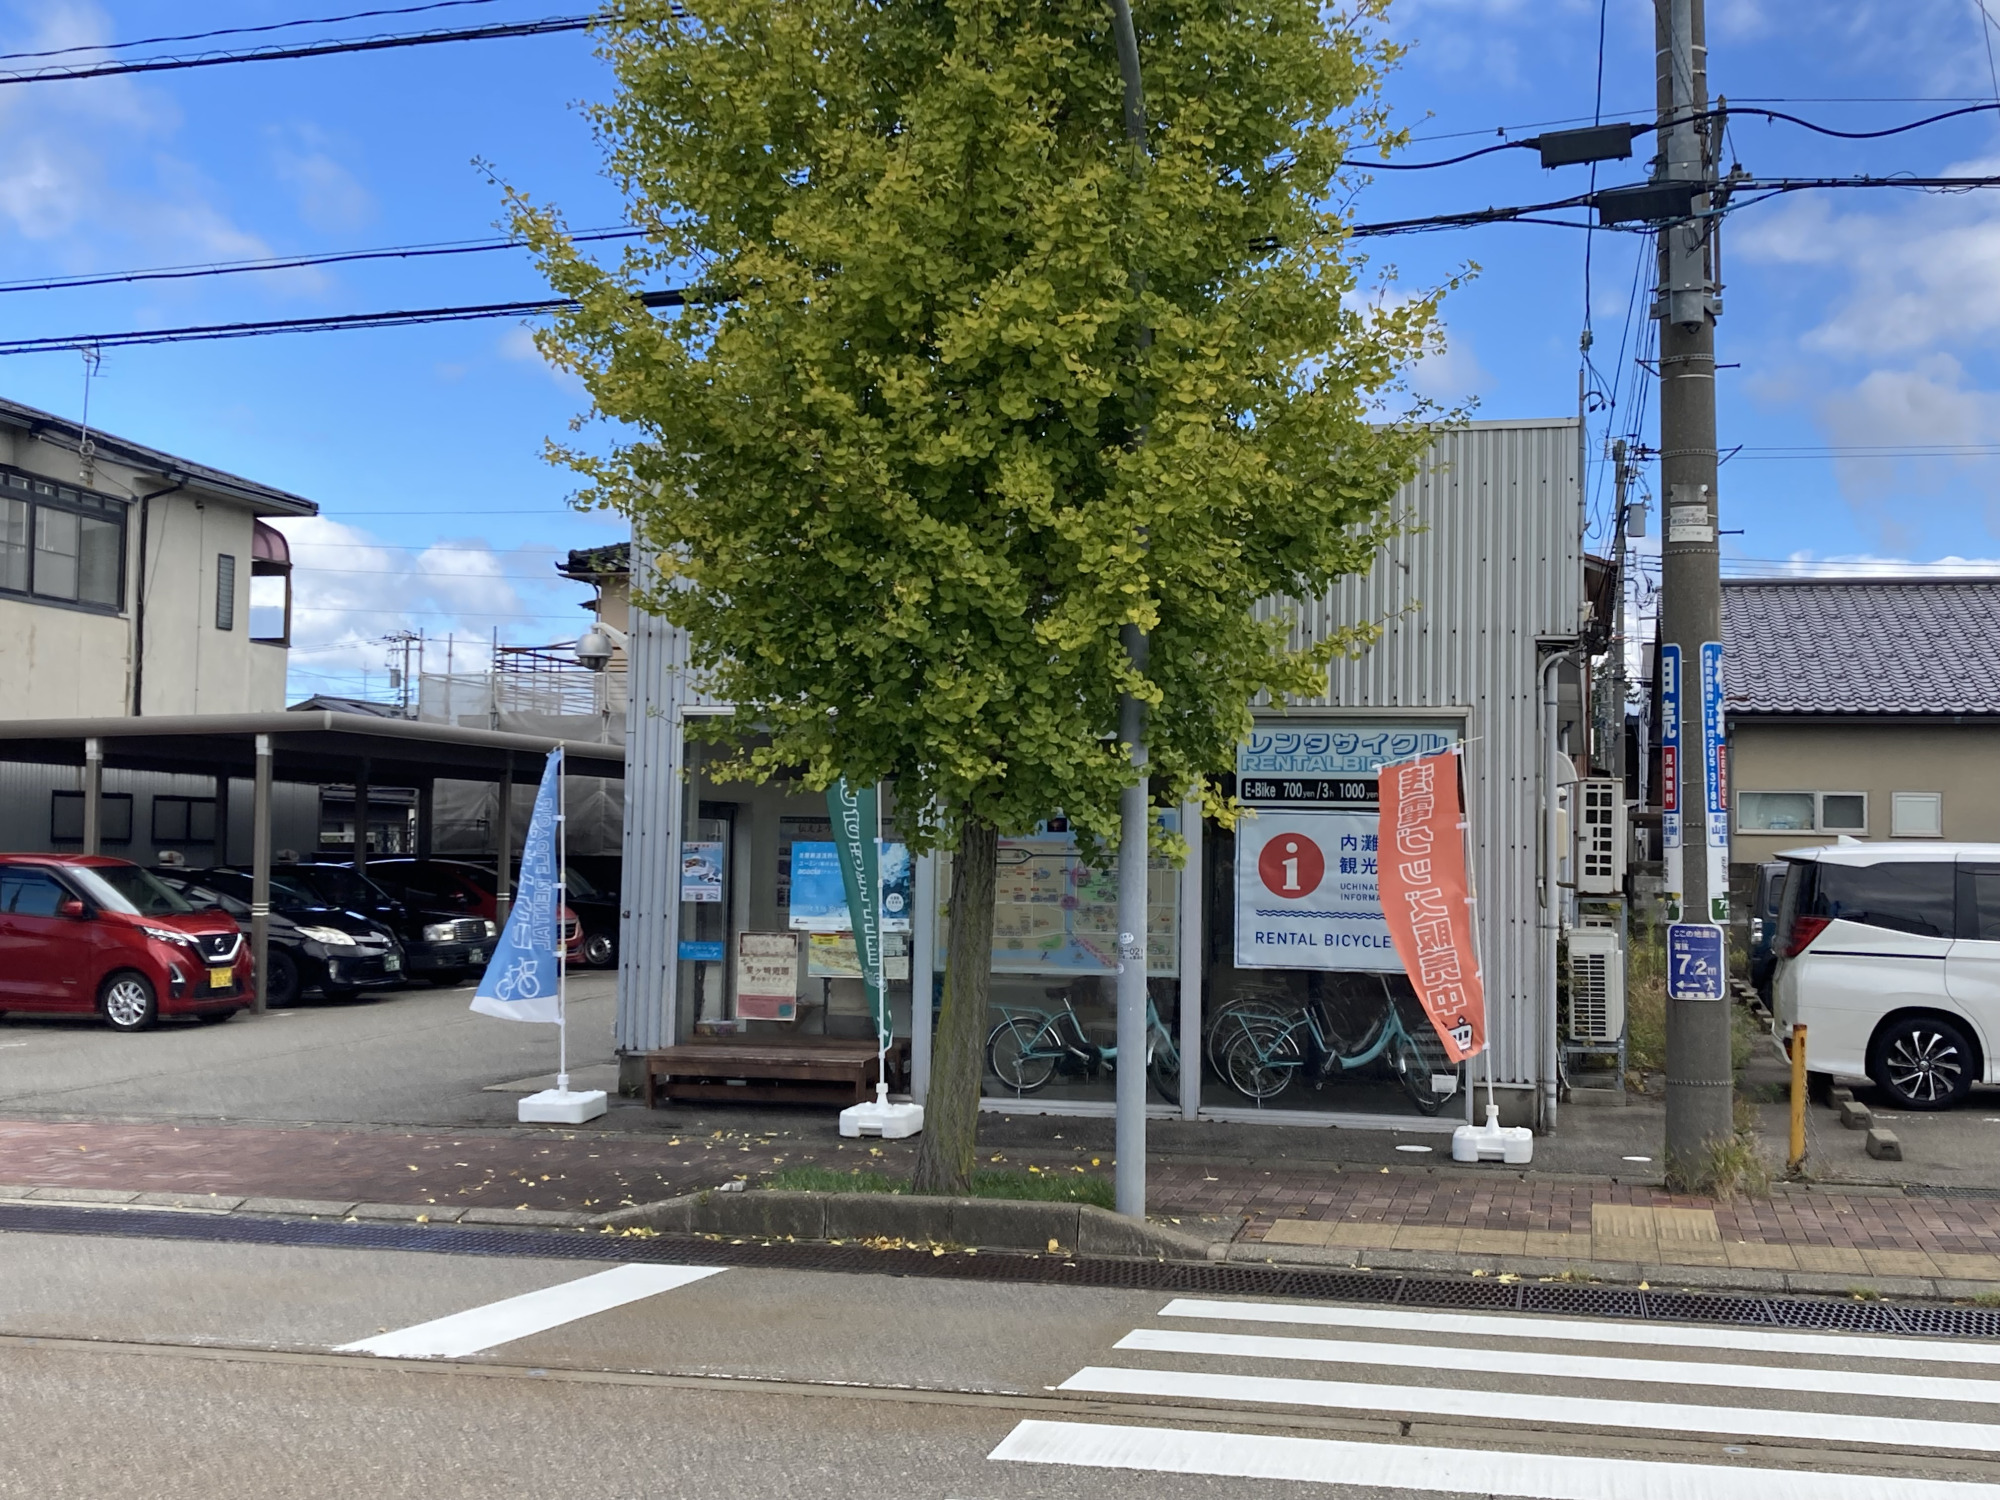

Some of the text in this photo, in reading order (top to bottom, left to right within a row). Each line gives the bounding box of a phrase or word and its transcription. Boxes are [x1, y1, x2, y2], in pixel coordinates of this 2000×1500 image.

[1246, 733, 1448, 756] レンタサイクル
[1245, 782, 1277, 798] E-Bike
[1340, 834, 1379, 851] 内灘
[1339, 856, 1379, 875] 観光
[1255, 931, 1392, 948] RENTAL BICYCLE
[1675, 953, 1717, 976] 7.2m
